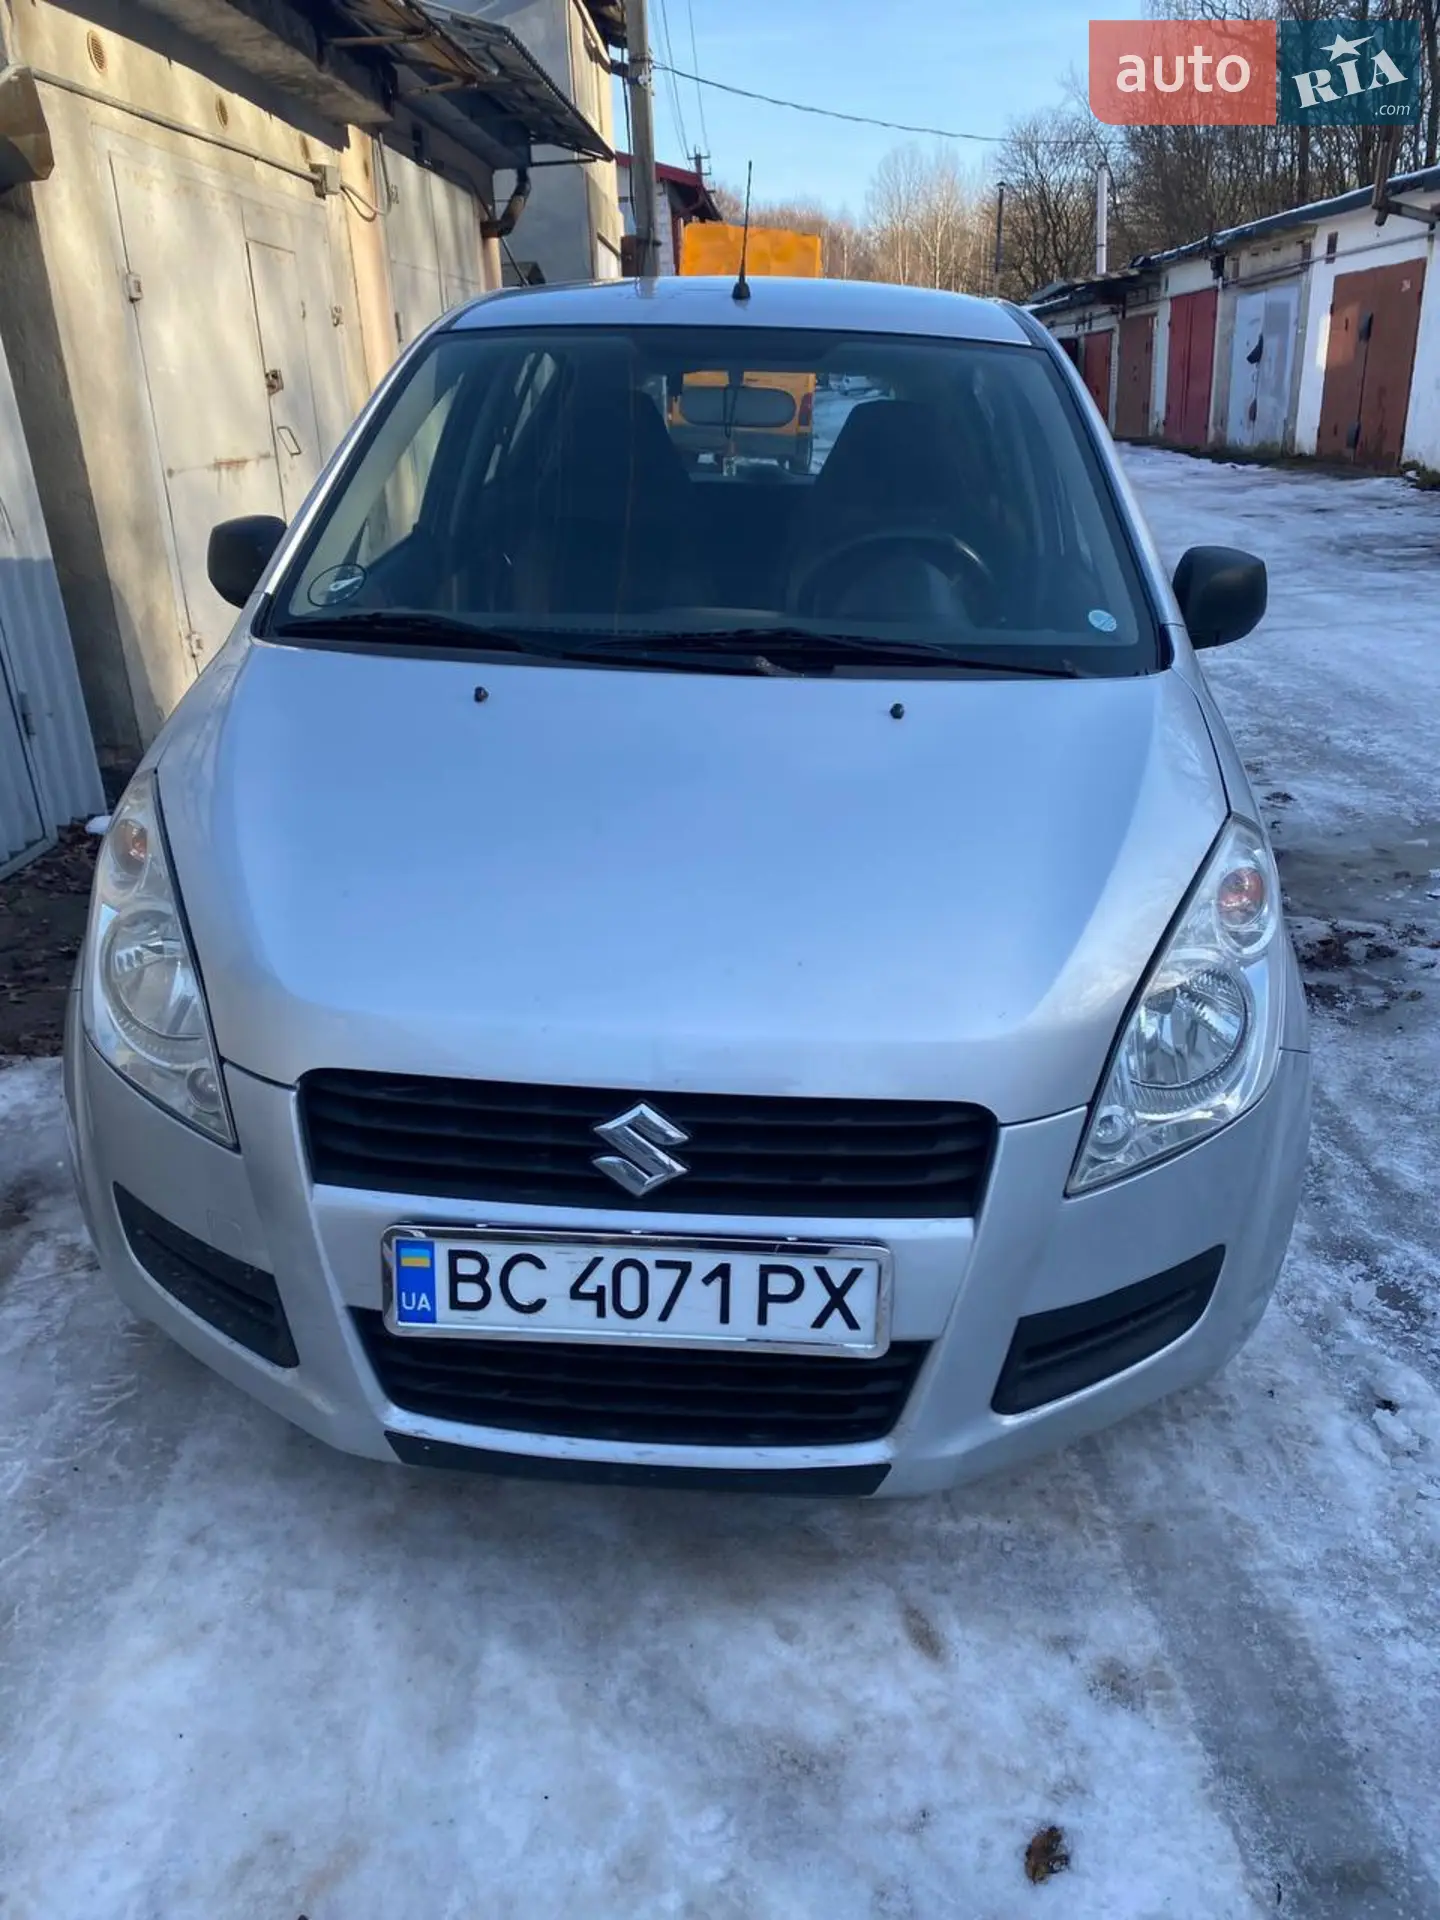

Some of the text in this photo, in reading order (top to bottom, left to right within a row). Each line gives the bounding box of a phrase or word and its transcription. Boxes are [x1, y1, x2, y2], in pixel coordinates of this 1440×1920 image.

[401, 1291, 432, 1311] UA
[447, 1248, 864, 1330] BC 4071 PX
